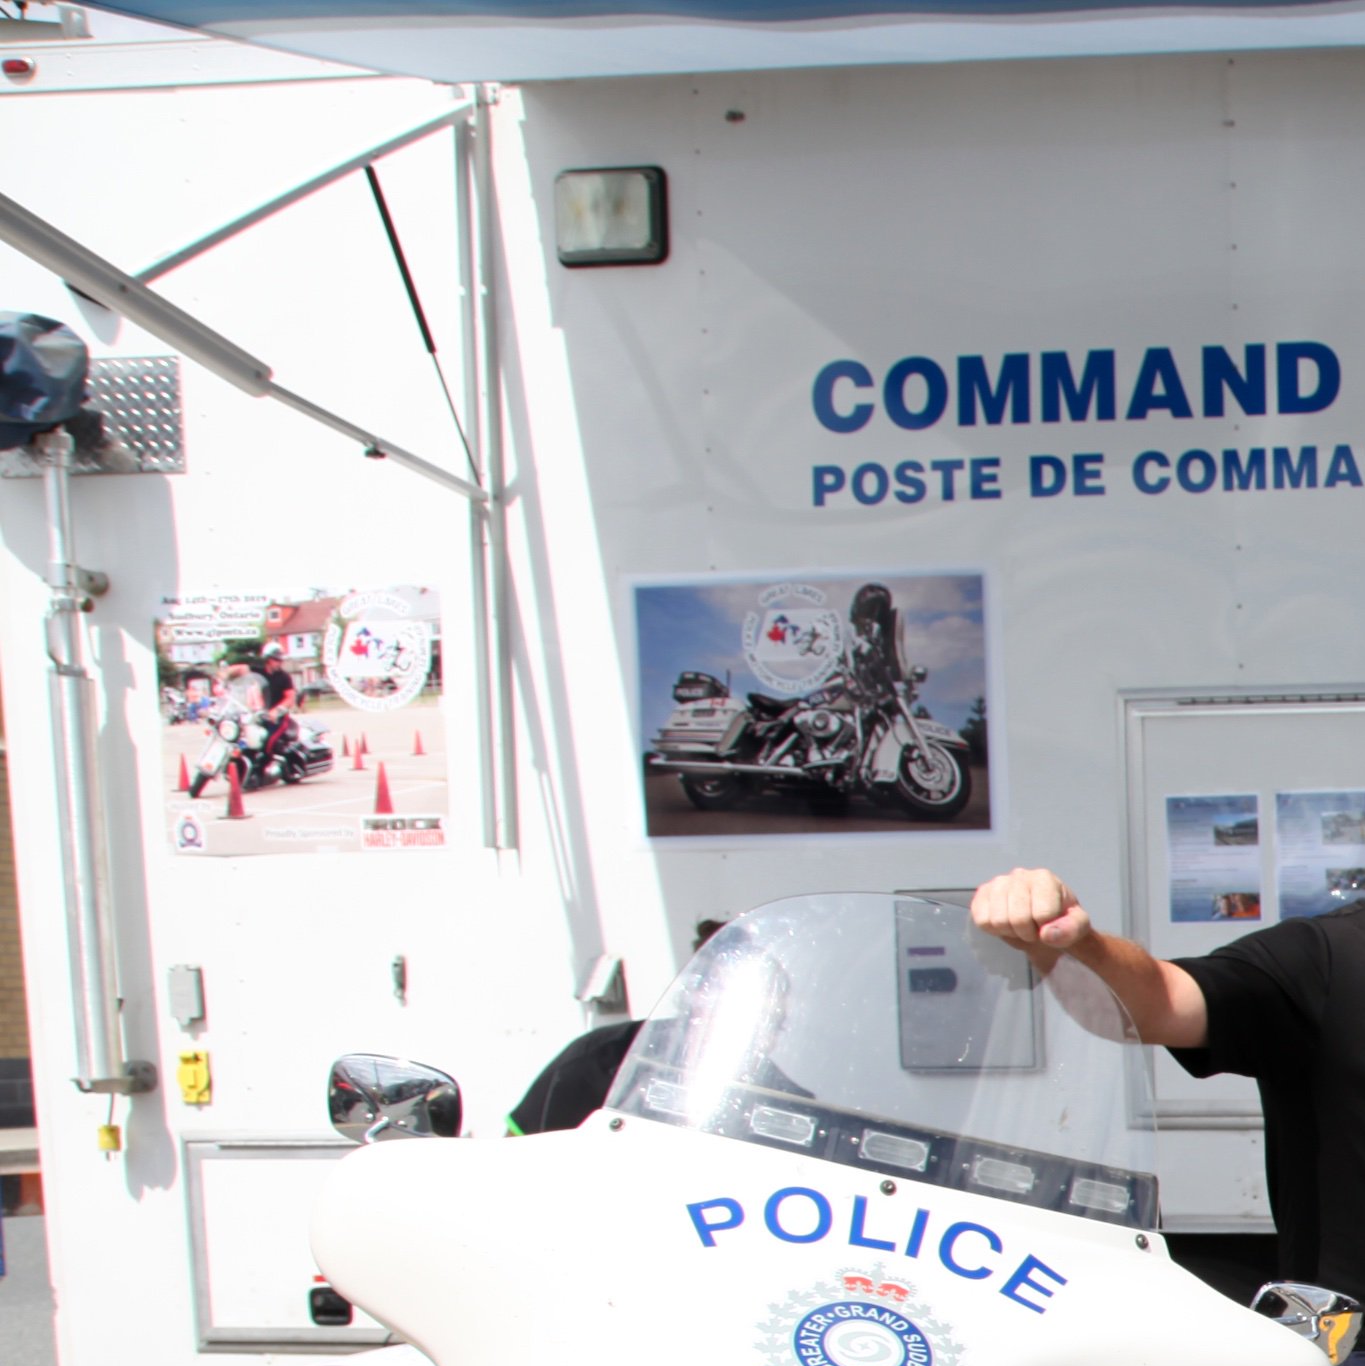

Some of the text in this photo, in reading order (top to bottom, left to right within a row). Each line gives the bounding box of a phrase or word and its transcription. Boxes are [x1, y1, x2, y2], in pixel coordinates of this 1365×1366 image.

[813, 341, 1341, 432] COMMAND
[812, 458, 1001, 505] POSTE
[1029, 452, 1106, 497] DE
[687, 1186, 1069, 1315] POLICE
[834, 1303, 909, 1332] GRAND
